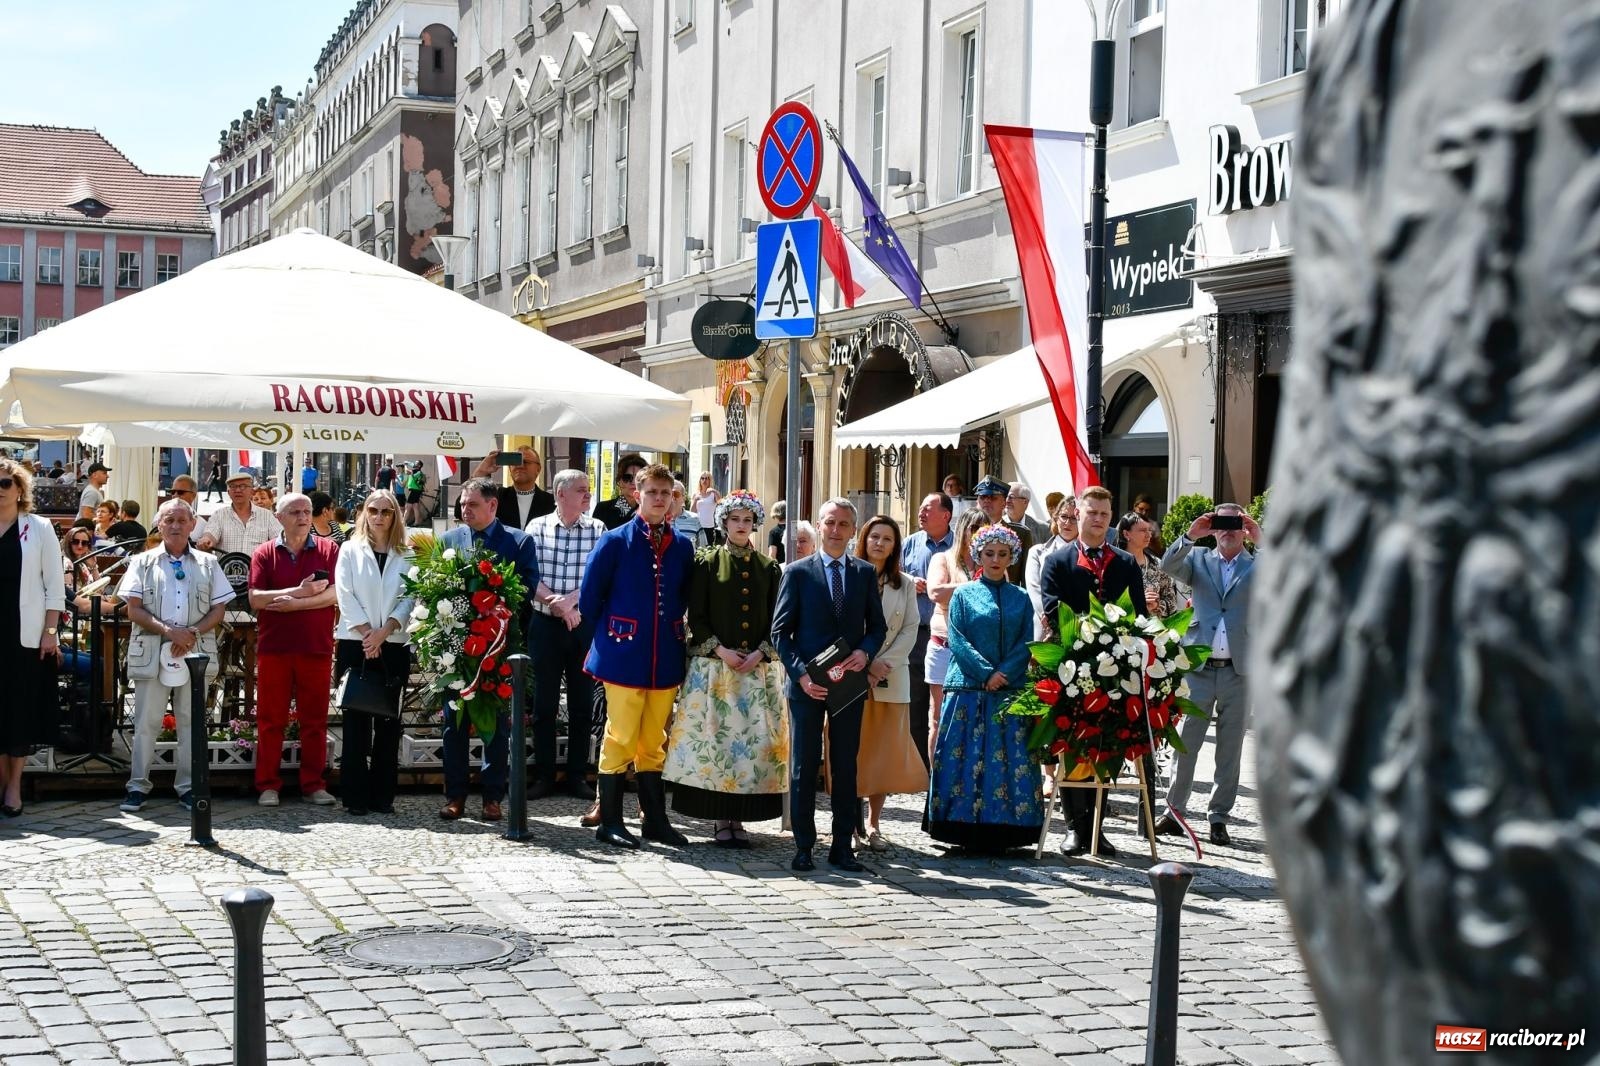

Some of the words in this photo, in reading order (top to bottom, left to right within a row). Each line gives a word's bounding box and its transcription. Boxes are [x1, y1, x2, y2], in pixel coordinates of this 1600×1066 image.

[1110, 243, 1184, 298] Wypieki
[1111, 303, 1131, 316] 2013
[270, 383, 478, 424] RACIBORSKIE
